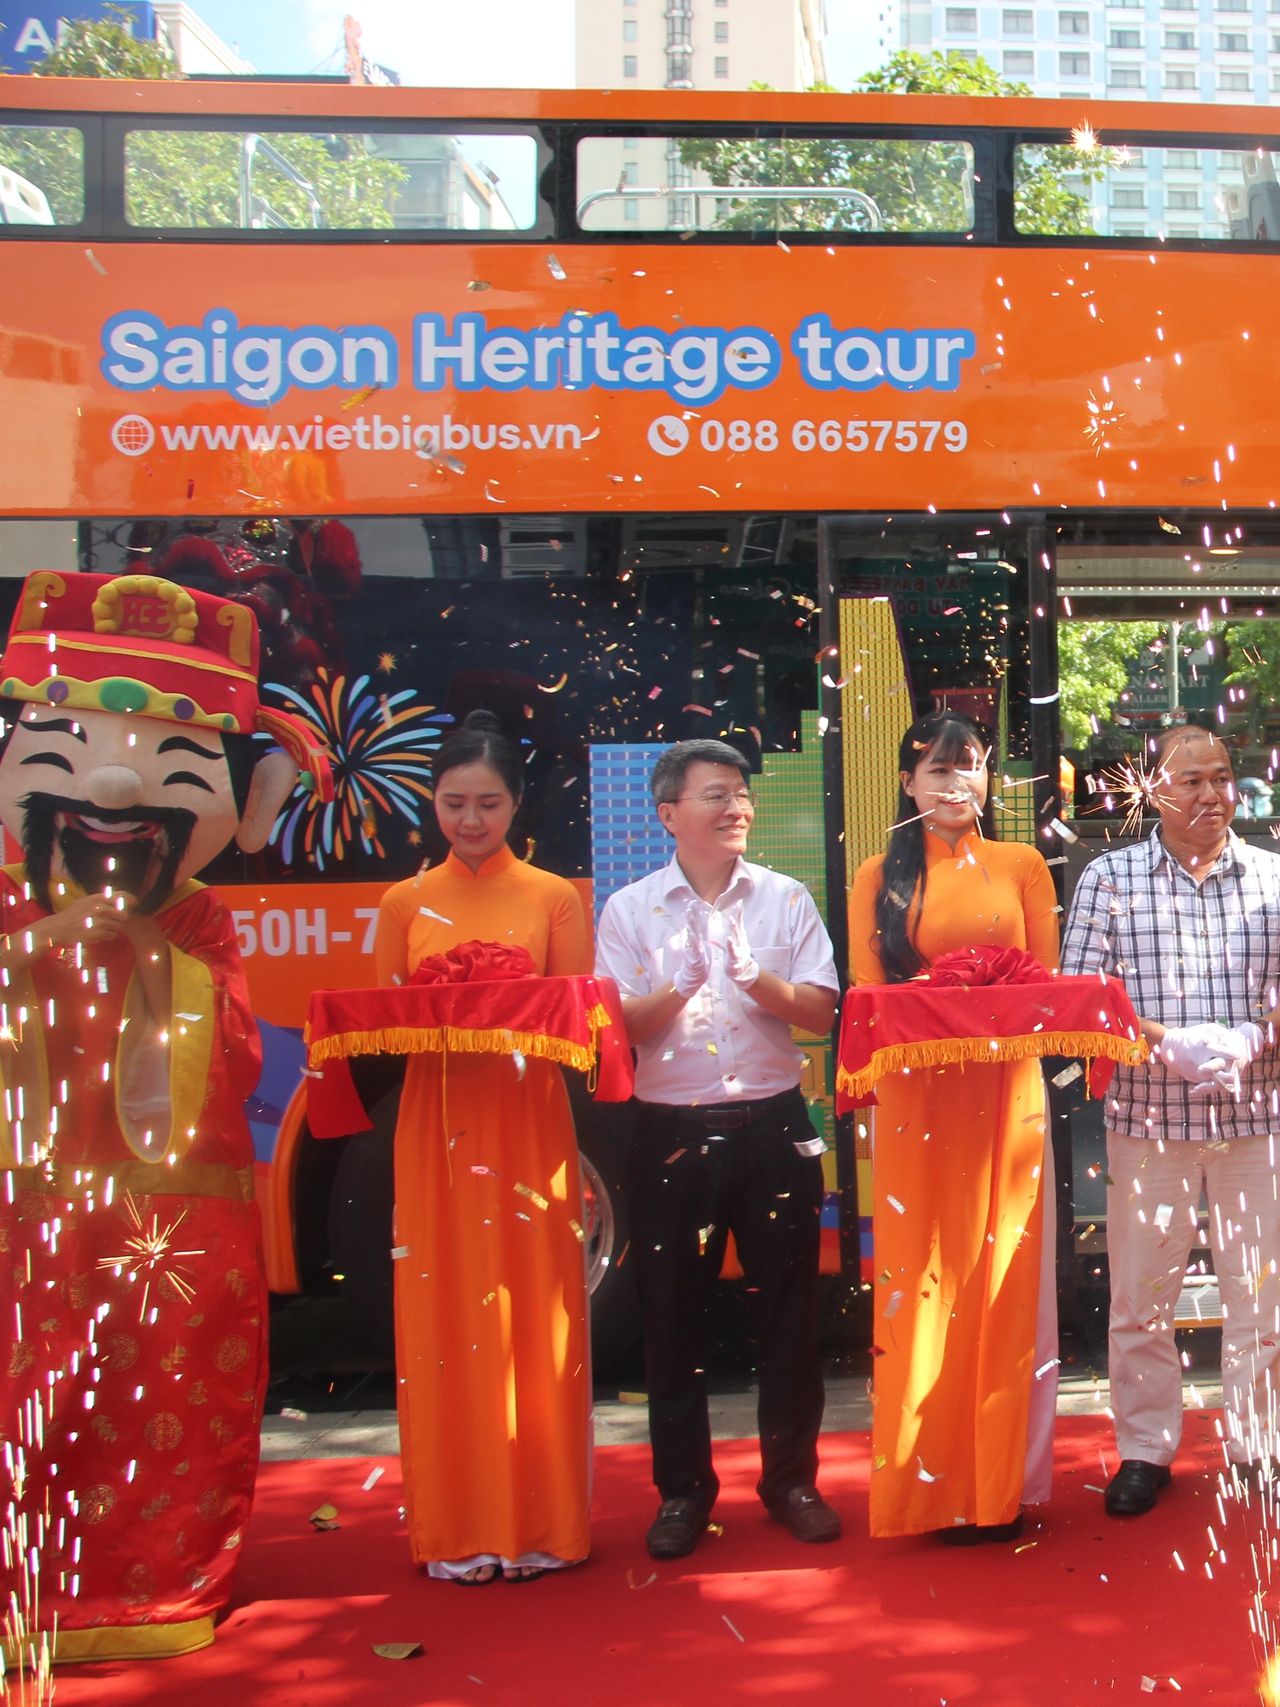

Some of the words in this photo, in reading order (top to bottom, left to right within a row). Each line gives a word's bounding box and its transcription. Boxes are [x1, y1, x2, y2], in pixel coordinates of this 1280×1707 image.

[107, 317, 391, 402] Saigon
[418, 317, 773, 400] Heritage
[797, 320, 966, 384] tour
[160, 414, 583, 460] www.vietbigbus.vn
[699, 419, 780, 453] 088
[790, 419, 969, 453] 6657579
